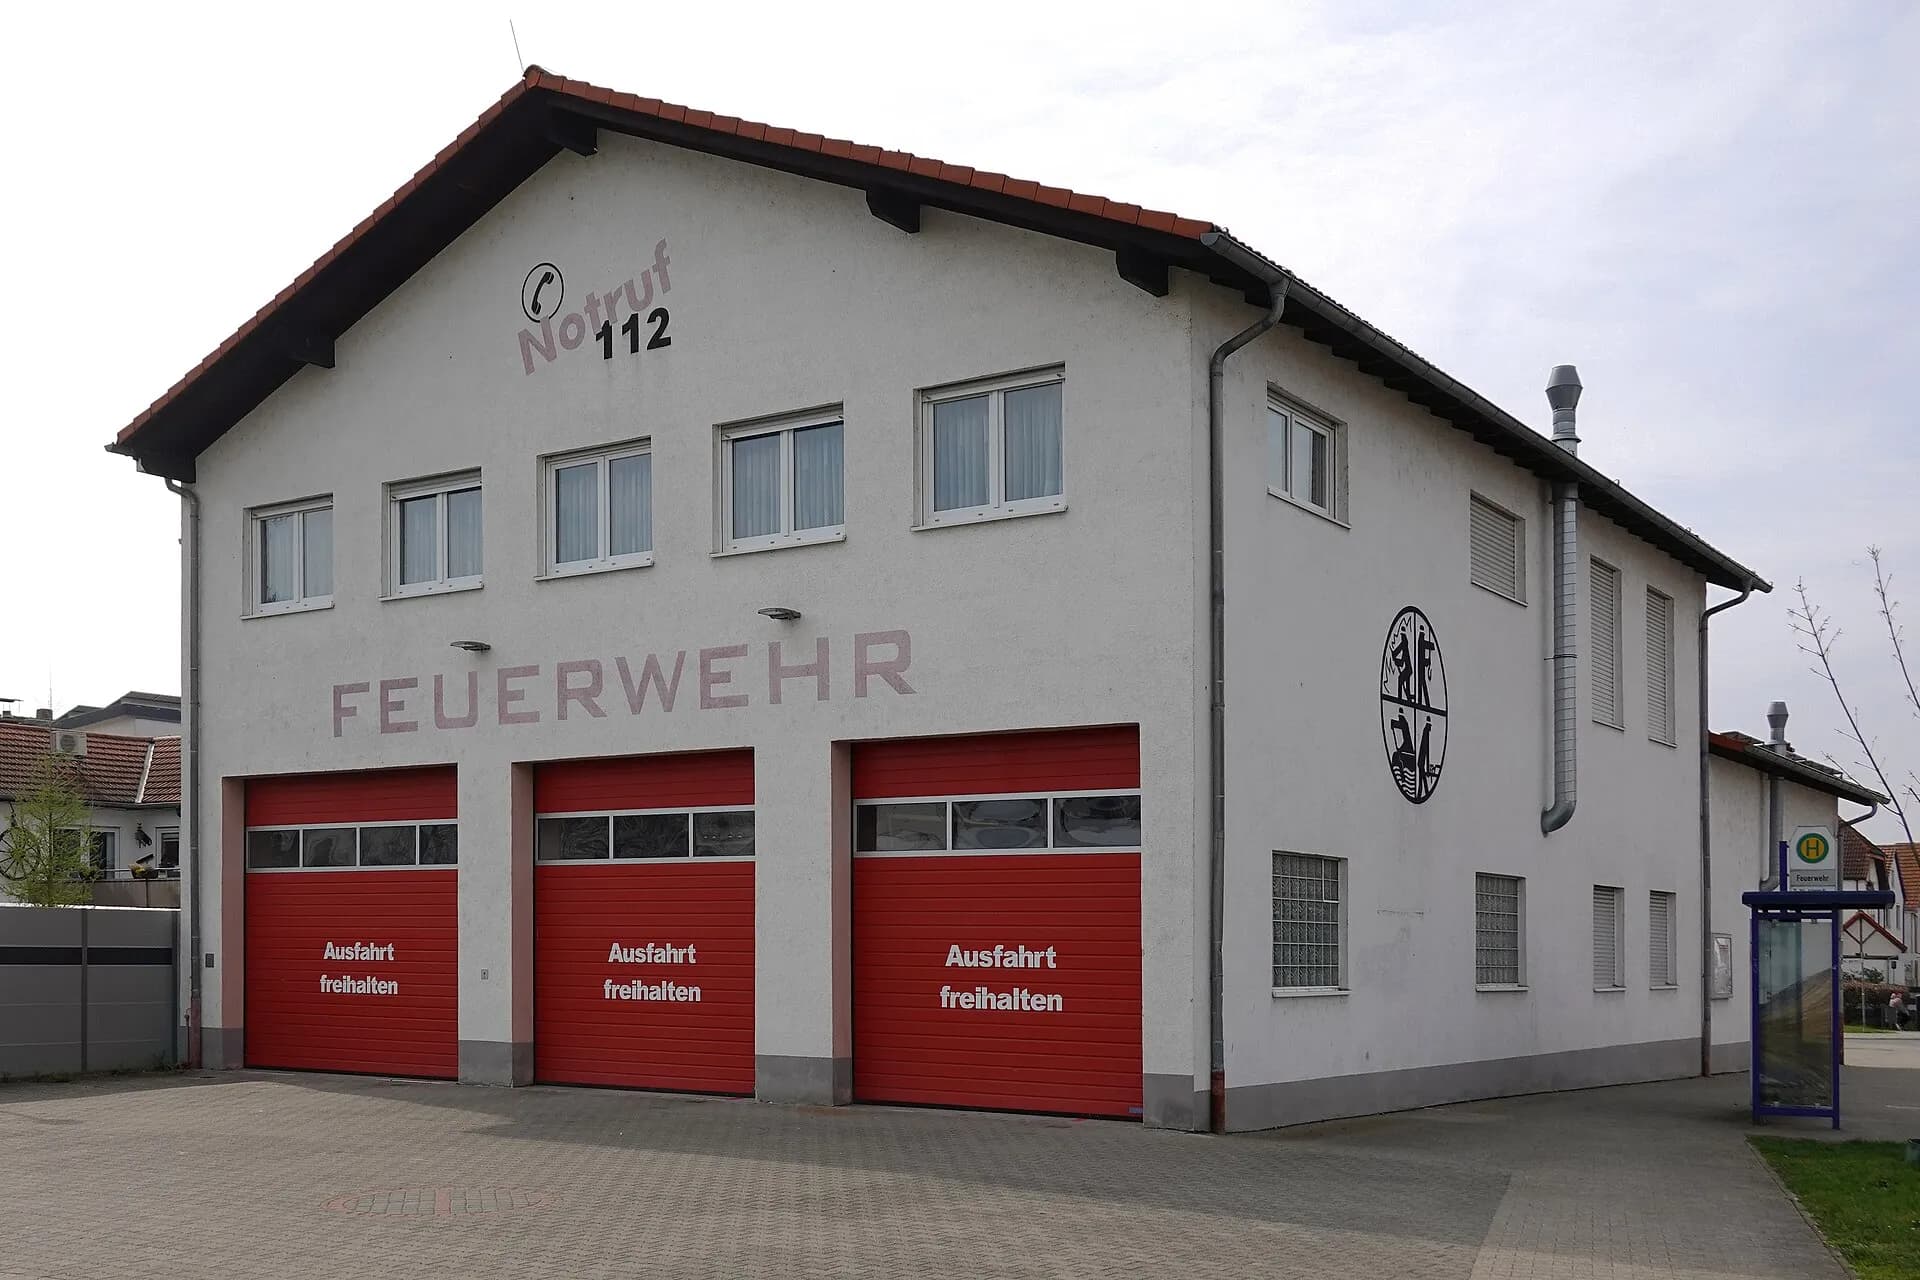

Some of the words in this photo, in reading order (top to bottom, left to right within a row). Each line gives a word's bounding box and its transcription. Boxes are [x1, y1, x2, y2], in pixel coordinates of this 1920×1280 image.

[518, 237, 672, 376] Notruf
[595, 307, 672, 360] 112
[332, 629, 917, 737] FEUERWEHR
[1806, 839, 1819, 857] H
[1796, 874, 1830, 882] Feuerwehr
[323, 941, 395, 961] Ausfahrt
[607, 942, 697, 964] Ausfahrt
[945, 944, 1057, 969] Ausfahrt
[319, 974, 399, 995] freihalten
[603, 979, 702, 1002] freihalten
[940, 985, 1063, 1012] freihalten
